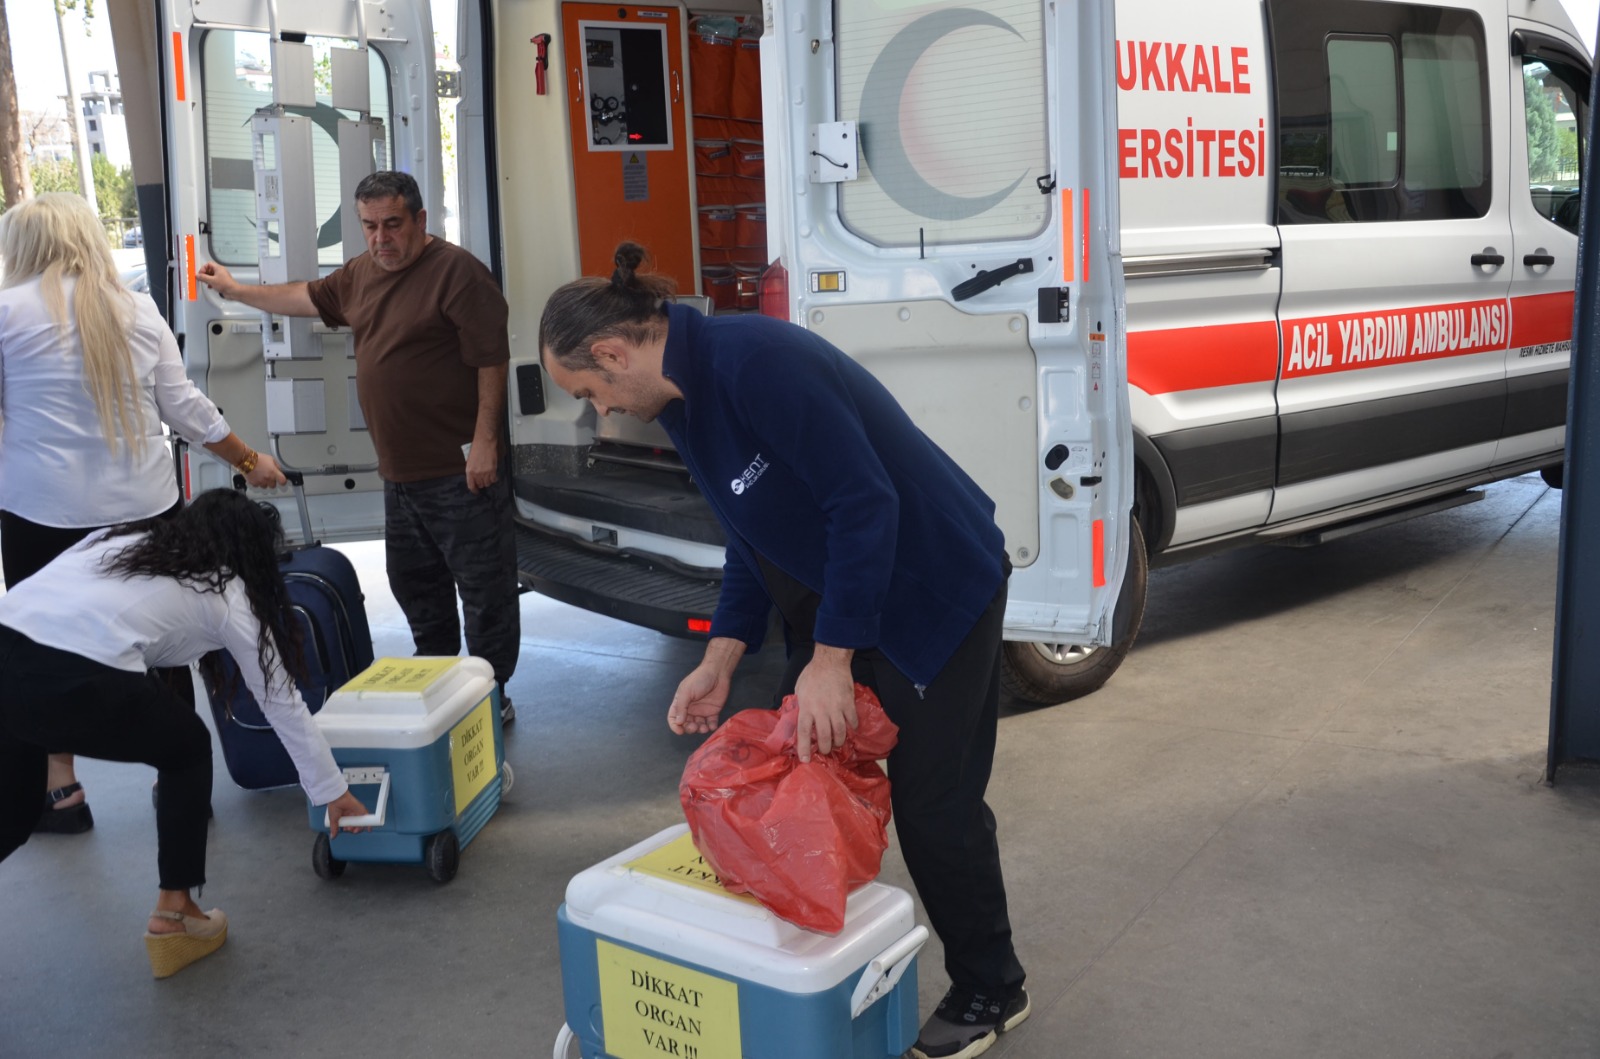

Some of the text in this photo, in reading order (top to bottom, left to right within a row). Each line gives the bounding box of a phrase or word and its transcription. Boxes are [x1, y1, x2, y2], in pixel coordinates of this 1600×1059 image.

[1115, 39, 1251, 94] UKKALE
[1118, 117, 1265, 179] ERSİTESİ
[1338, 313, 1408, 365] YARDIM
[1410, 304, 1505, 356] AMBULANSI
[464, 738, 484, 766] ORGAN
[631, 969, 703, 1008] DİKKAT
[635, 999, 702, 1036] ORGAN
[642, 1028, 680, 1056] VAR
